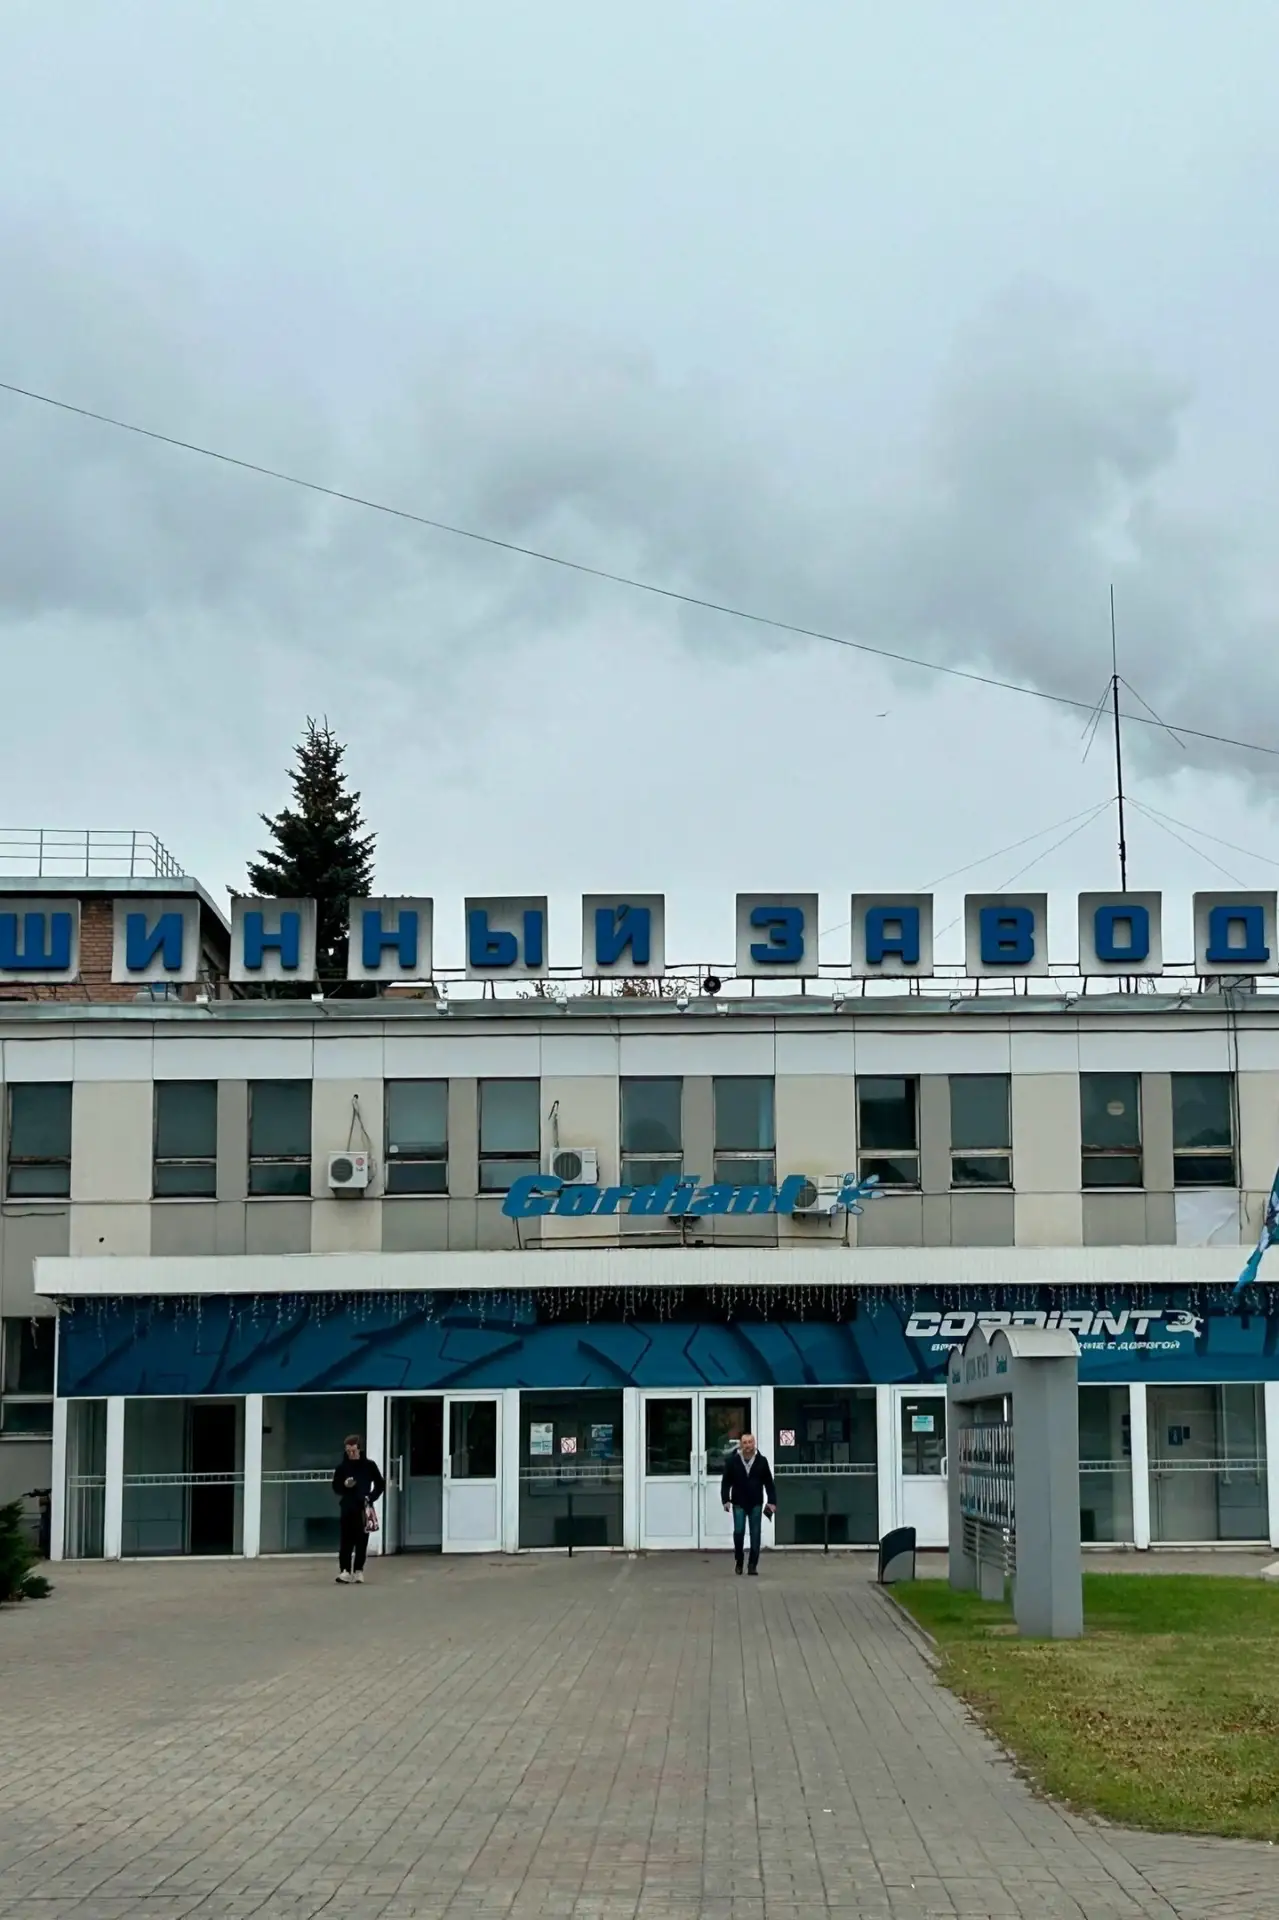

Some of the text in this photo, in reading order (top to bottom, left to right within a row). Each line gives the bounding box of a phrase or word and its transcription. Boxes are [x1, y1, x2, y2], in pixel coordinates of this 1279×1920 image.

[0, 902, 1270, 971] ШИННЫЙ ЗАВОД
[501, 1174, 806, 1217] Cordiant
[1117, 1340, 1181, 1351] ДОРОГОЙ
